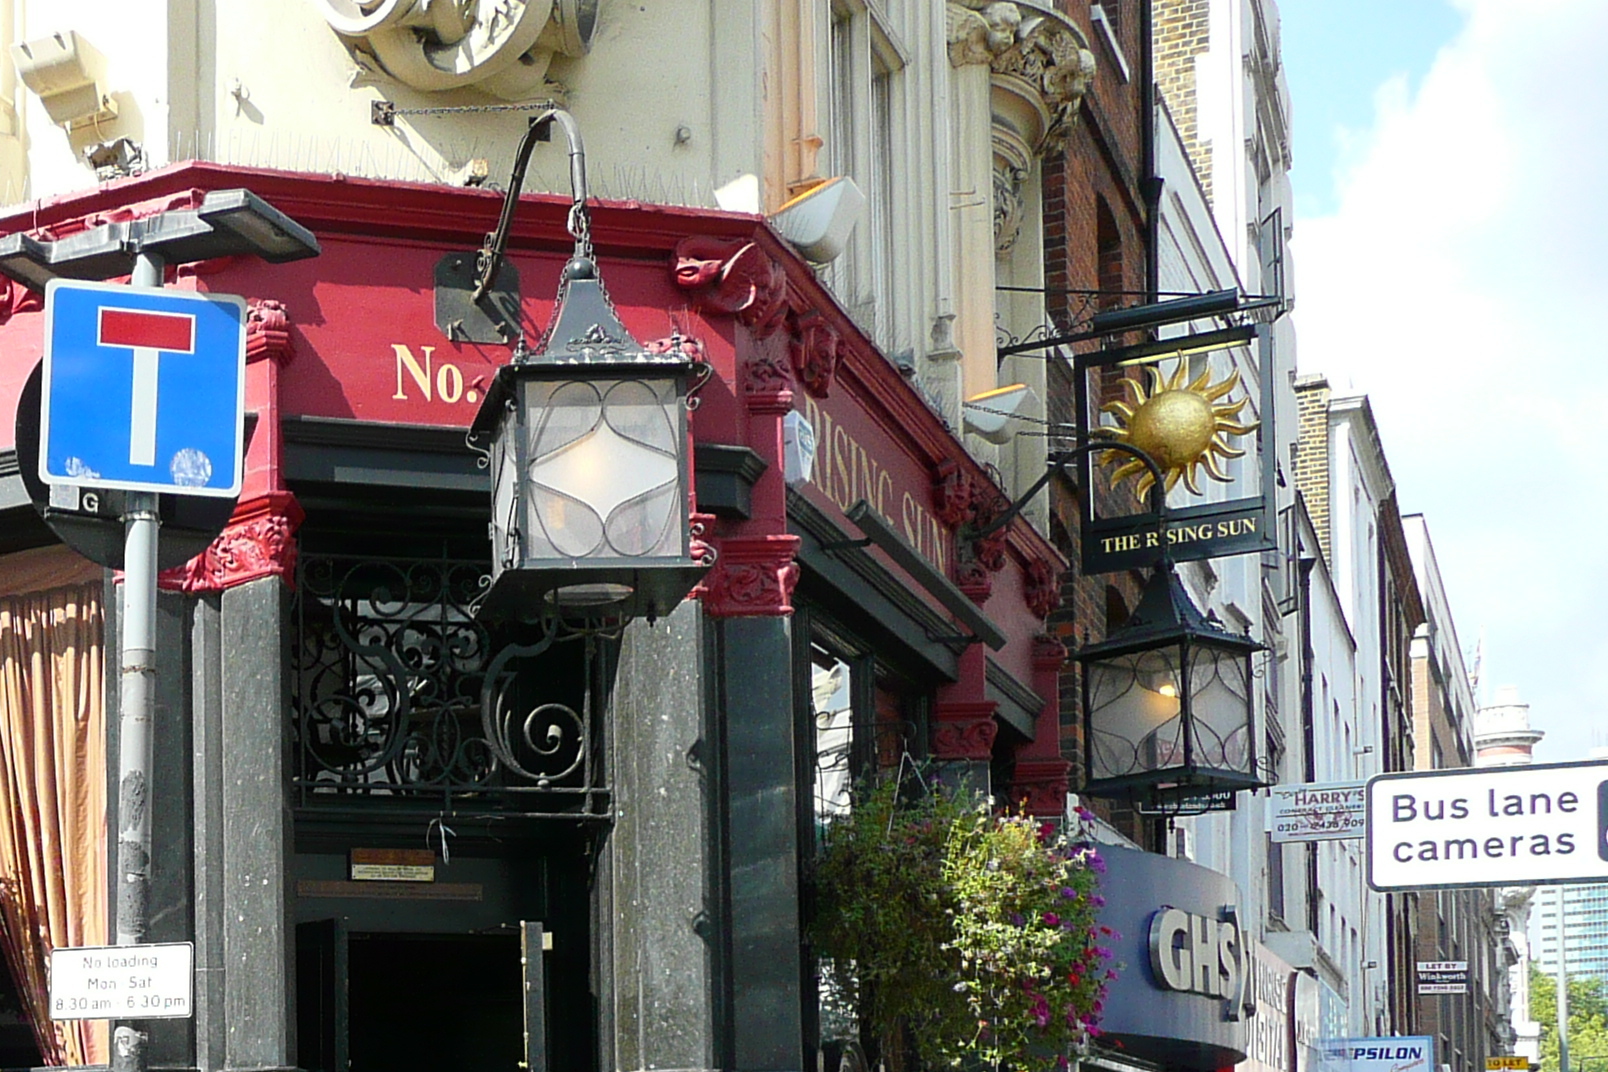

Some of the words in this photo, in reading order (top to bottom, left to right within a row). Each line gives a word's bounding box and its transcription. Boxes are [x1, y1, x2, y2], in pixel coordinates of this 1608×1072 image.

[391, 343, 478, 404] No.
[82, 492, 99, 514] G
[1100, 534, 1141, 554] THE
[1146, 523, 1214, 548] RSING
[1217, 517, 1257, 538] SUN
[1294, 789, 1365, 807] HARRY'S
[1392, 793, 1470, 823] Bus
[1488, 787, 1579, 817] lane
[1392, 832, 1576, 863] cameras
[83, 957, 101, 969] No
[107, 954, 158, 969] loading
[88, 978, 117, 990] Mon
[128, 975, 152, 989] Sat
[1502, 1059, 1521, 1067] LET
